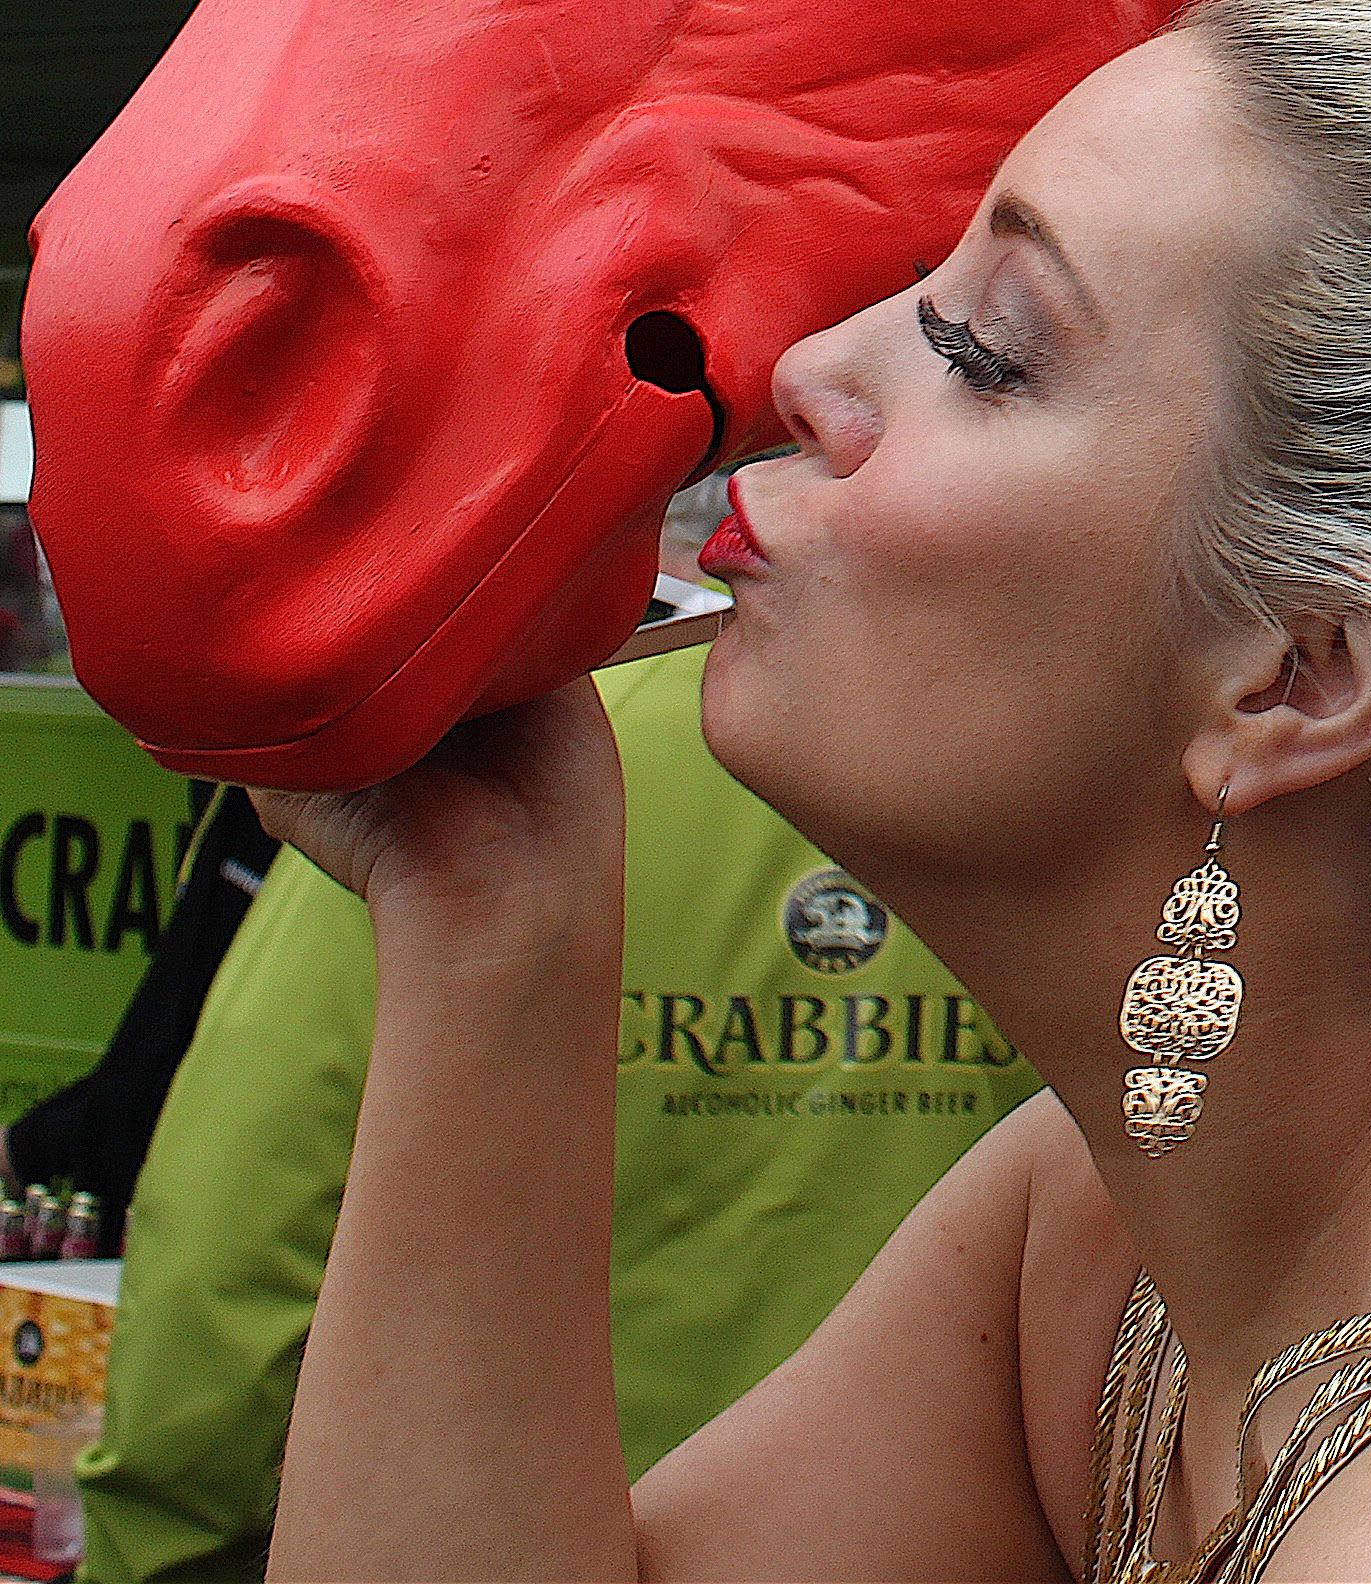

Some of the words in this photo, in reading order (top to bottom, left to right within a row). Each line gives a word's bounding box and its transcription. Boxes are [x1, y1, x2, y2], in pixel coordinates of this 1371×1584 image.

[662, 1092, 799, 1116] ALCOHOLIC
[810, 1091, 907, 1116] GINGER
[917, 1091, 978, 1116] BEER
